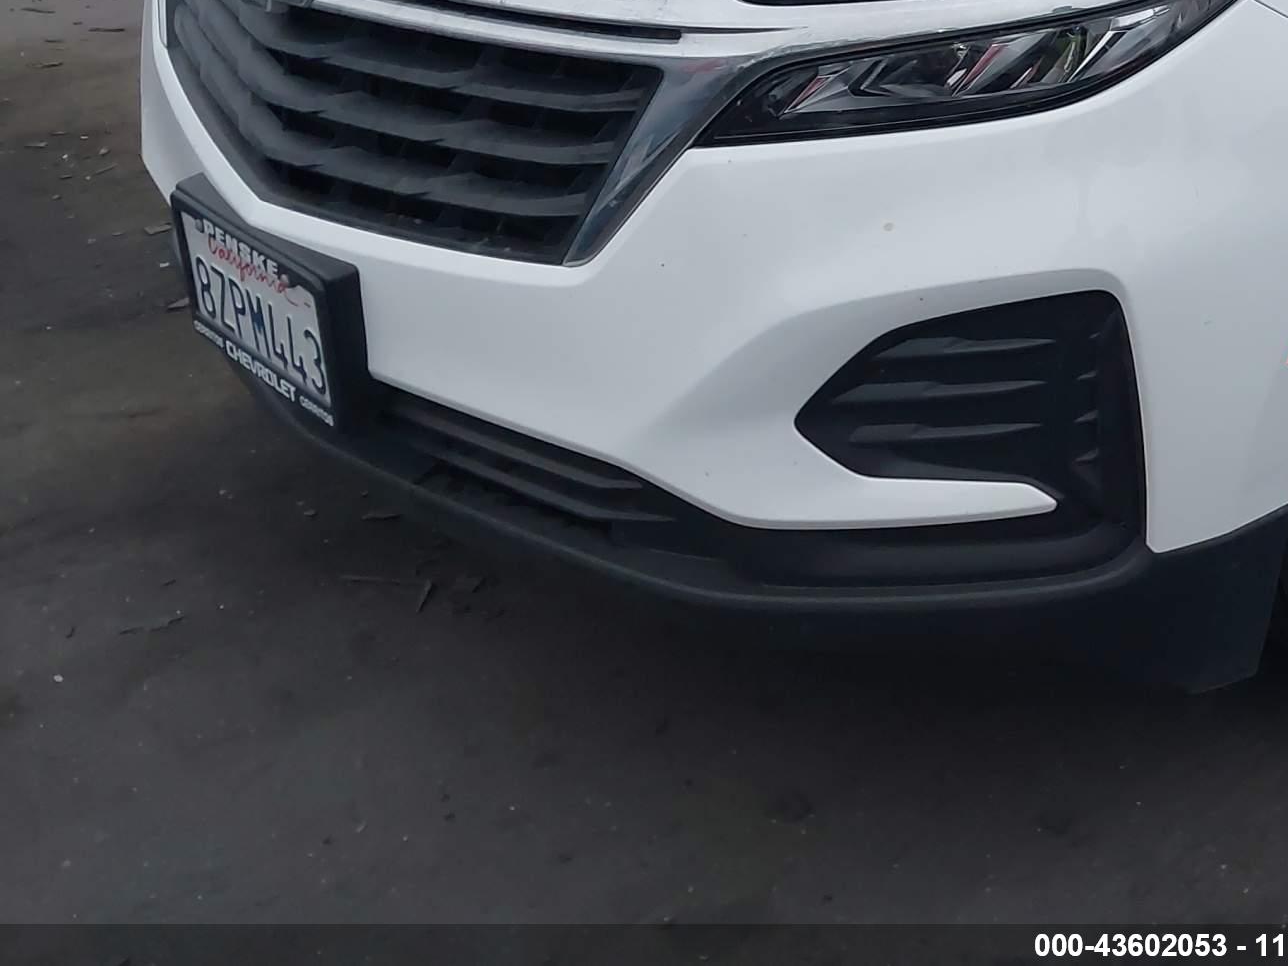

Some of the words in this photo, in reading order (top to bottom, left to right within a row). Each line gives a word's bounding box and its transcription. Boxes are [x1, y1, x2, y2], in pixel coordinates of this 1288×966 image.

[203, 219, 279, 276] PENSKE
[195, 256, 327, 396] 8ZPM443
[226, 340, 296, 402] CHEVROLET
